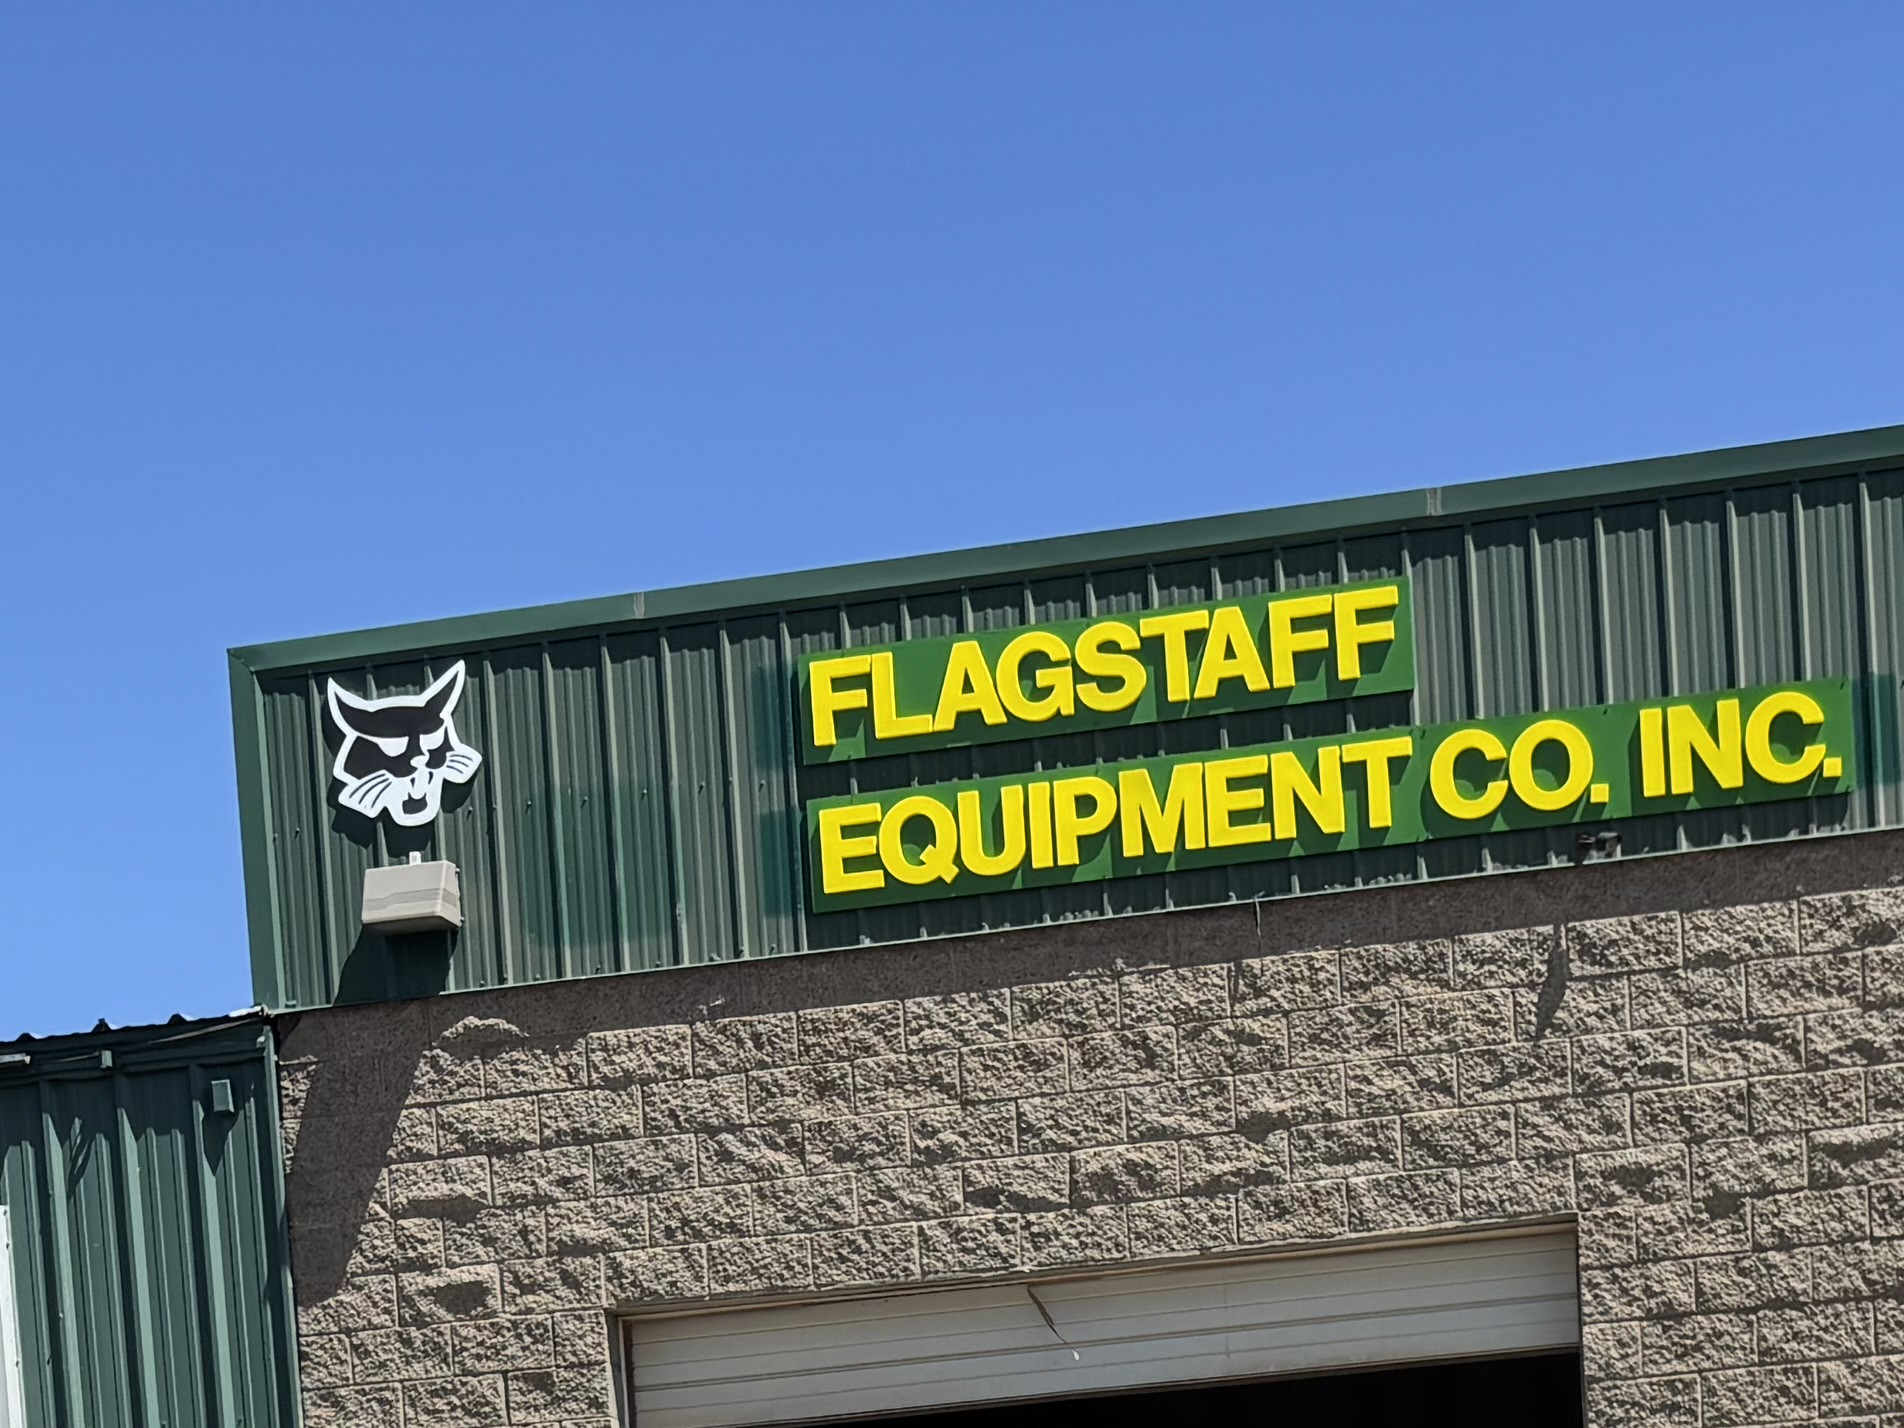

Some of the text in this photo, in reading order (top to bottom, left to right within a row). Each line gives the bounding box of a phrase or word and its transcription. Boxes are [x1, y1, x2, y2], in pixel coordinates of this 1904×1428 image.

[809, 585, 1401, 747] FLAGSTAFF
[818, 691, 1842, 895] EQUIPMENT CO. INC.
